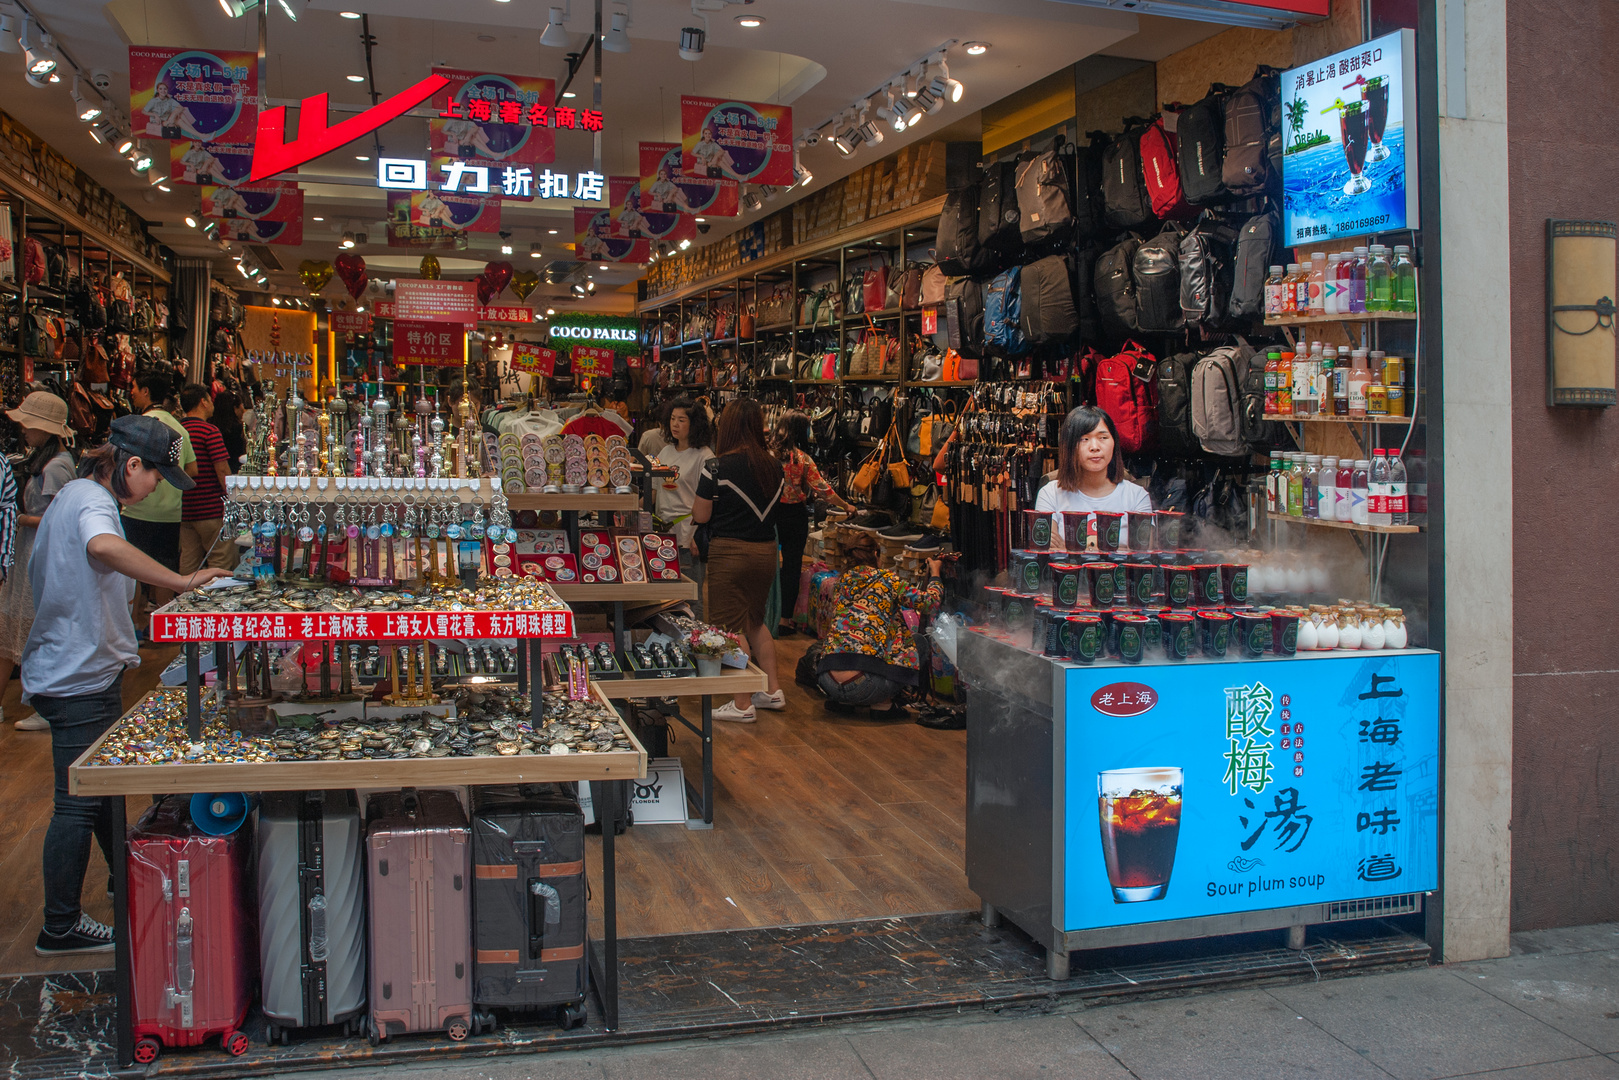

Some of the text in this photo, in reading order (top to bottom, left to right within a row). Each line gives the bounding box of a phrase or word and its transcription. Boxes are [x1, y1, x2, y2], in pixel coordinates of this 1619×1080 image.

[169, 62, 249, 80] 全场1-5折
[1296, 48, 1382, 90] 消暑止渴 酸甜爽口
[439, 96, 604, 132] 上海著名商标
[1294, 129, 1322, 144] DREAM
[1336, 214, 1390, 232] 18601698697
[407, 331, 452, 346] 特价区
[550, 326, 636, 341] COCO PARLS
[410, 346, 448, 355] SALE
[521, 356, 534, 364] 59
[1098, 691, 1152, 706] 老上海
[1357, 672, 1403, 882] 上海老味道
[632, 785, 662, 799] OY
[1206, 872, 1325, 897] Sour plum soup
